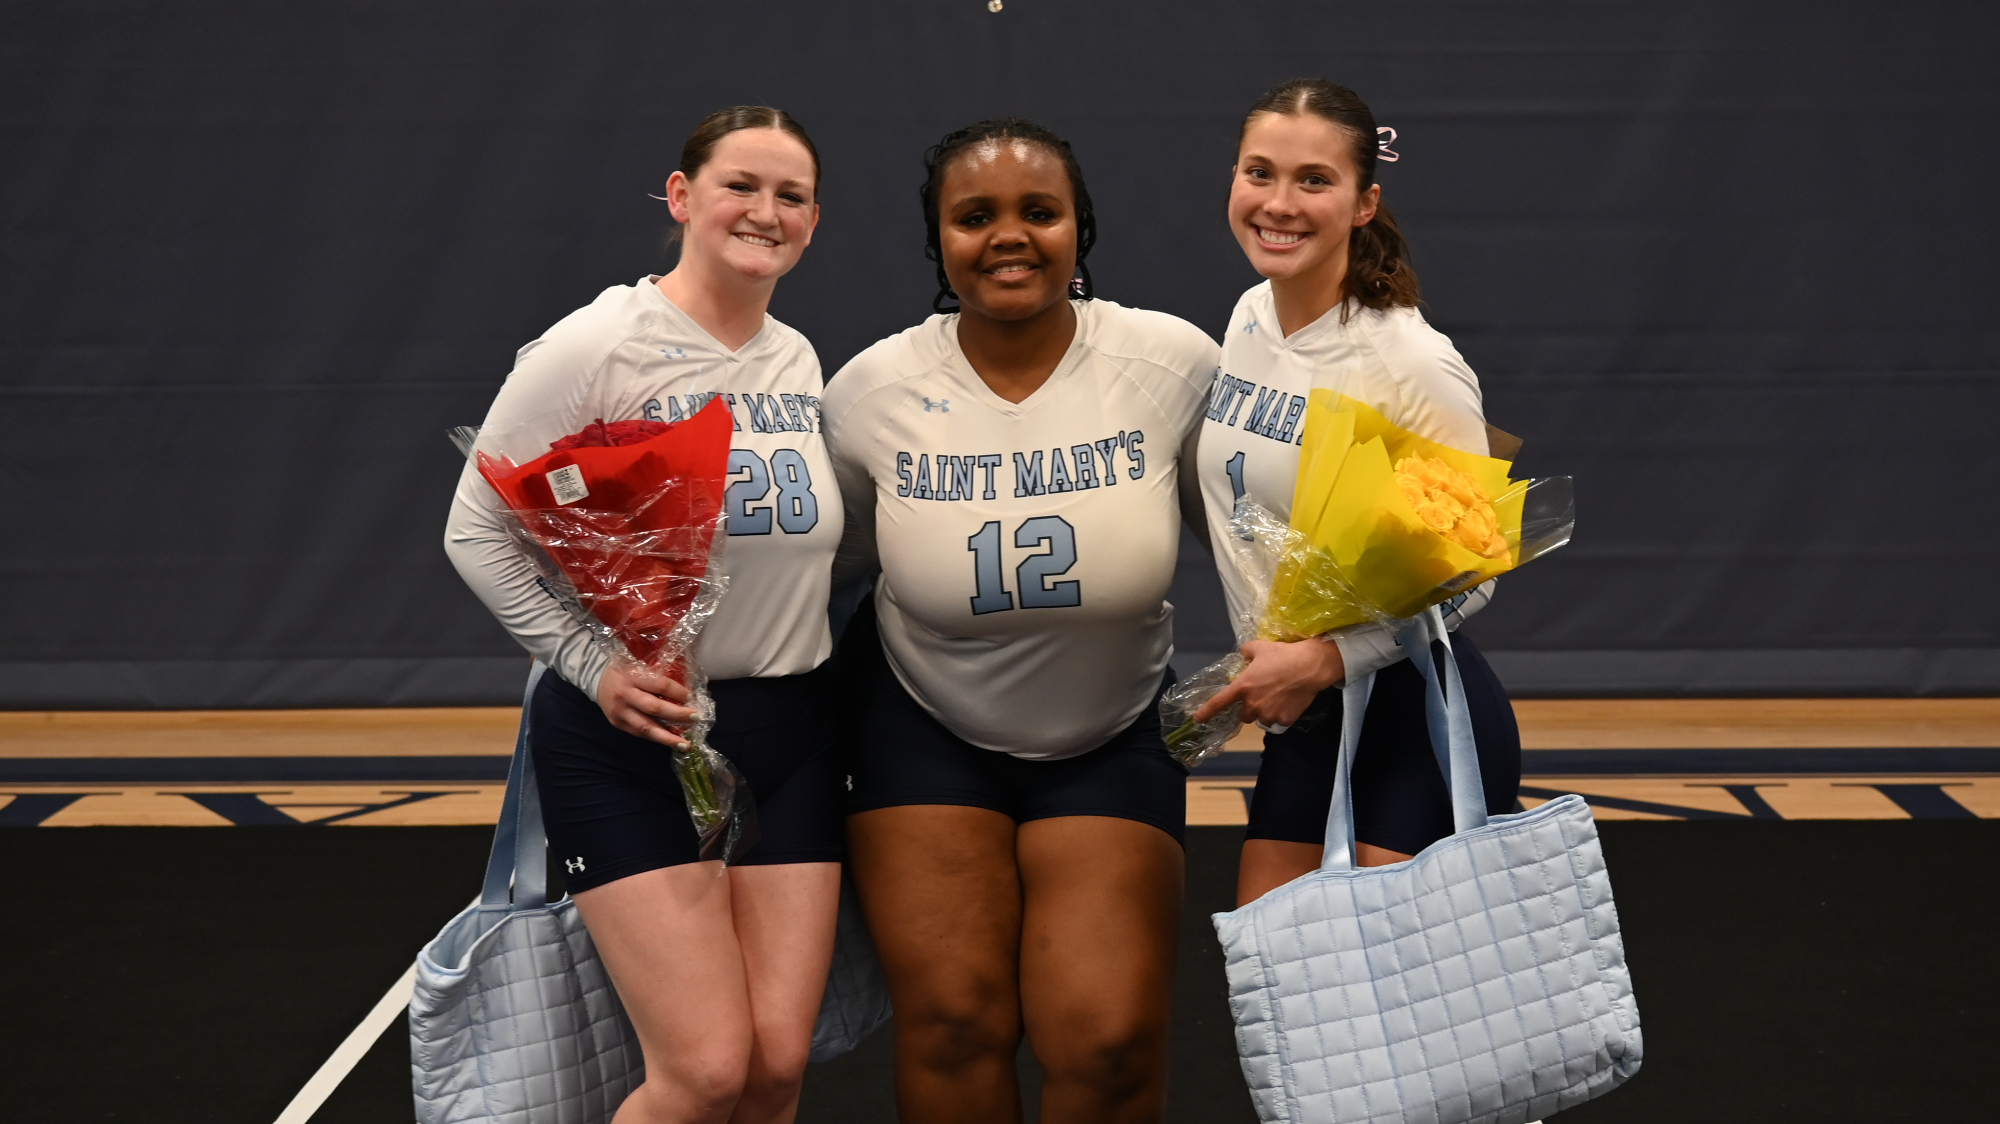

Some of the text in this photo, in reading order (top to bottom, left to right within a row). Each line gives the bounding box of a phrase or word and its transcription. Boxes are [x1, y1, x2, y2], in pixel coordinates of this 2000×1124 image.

[724, 448, 818, 536] 28
[897, 430, 1145, 501] SAINT MARY'S
[1226, 450, 1246, 513] 1
[968, 515, 1082, 616] 12
